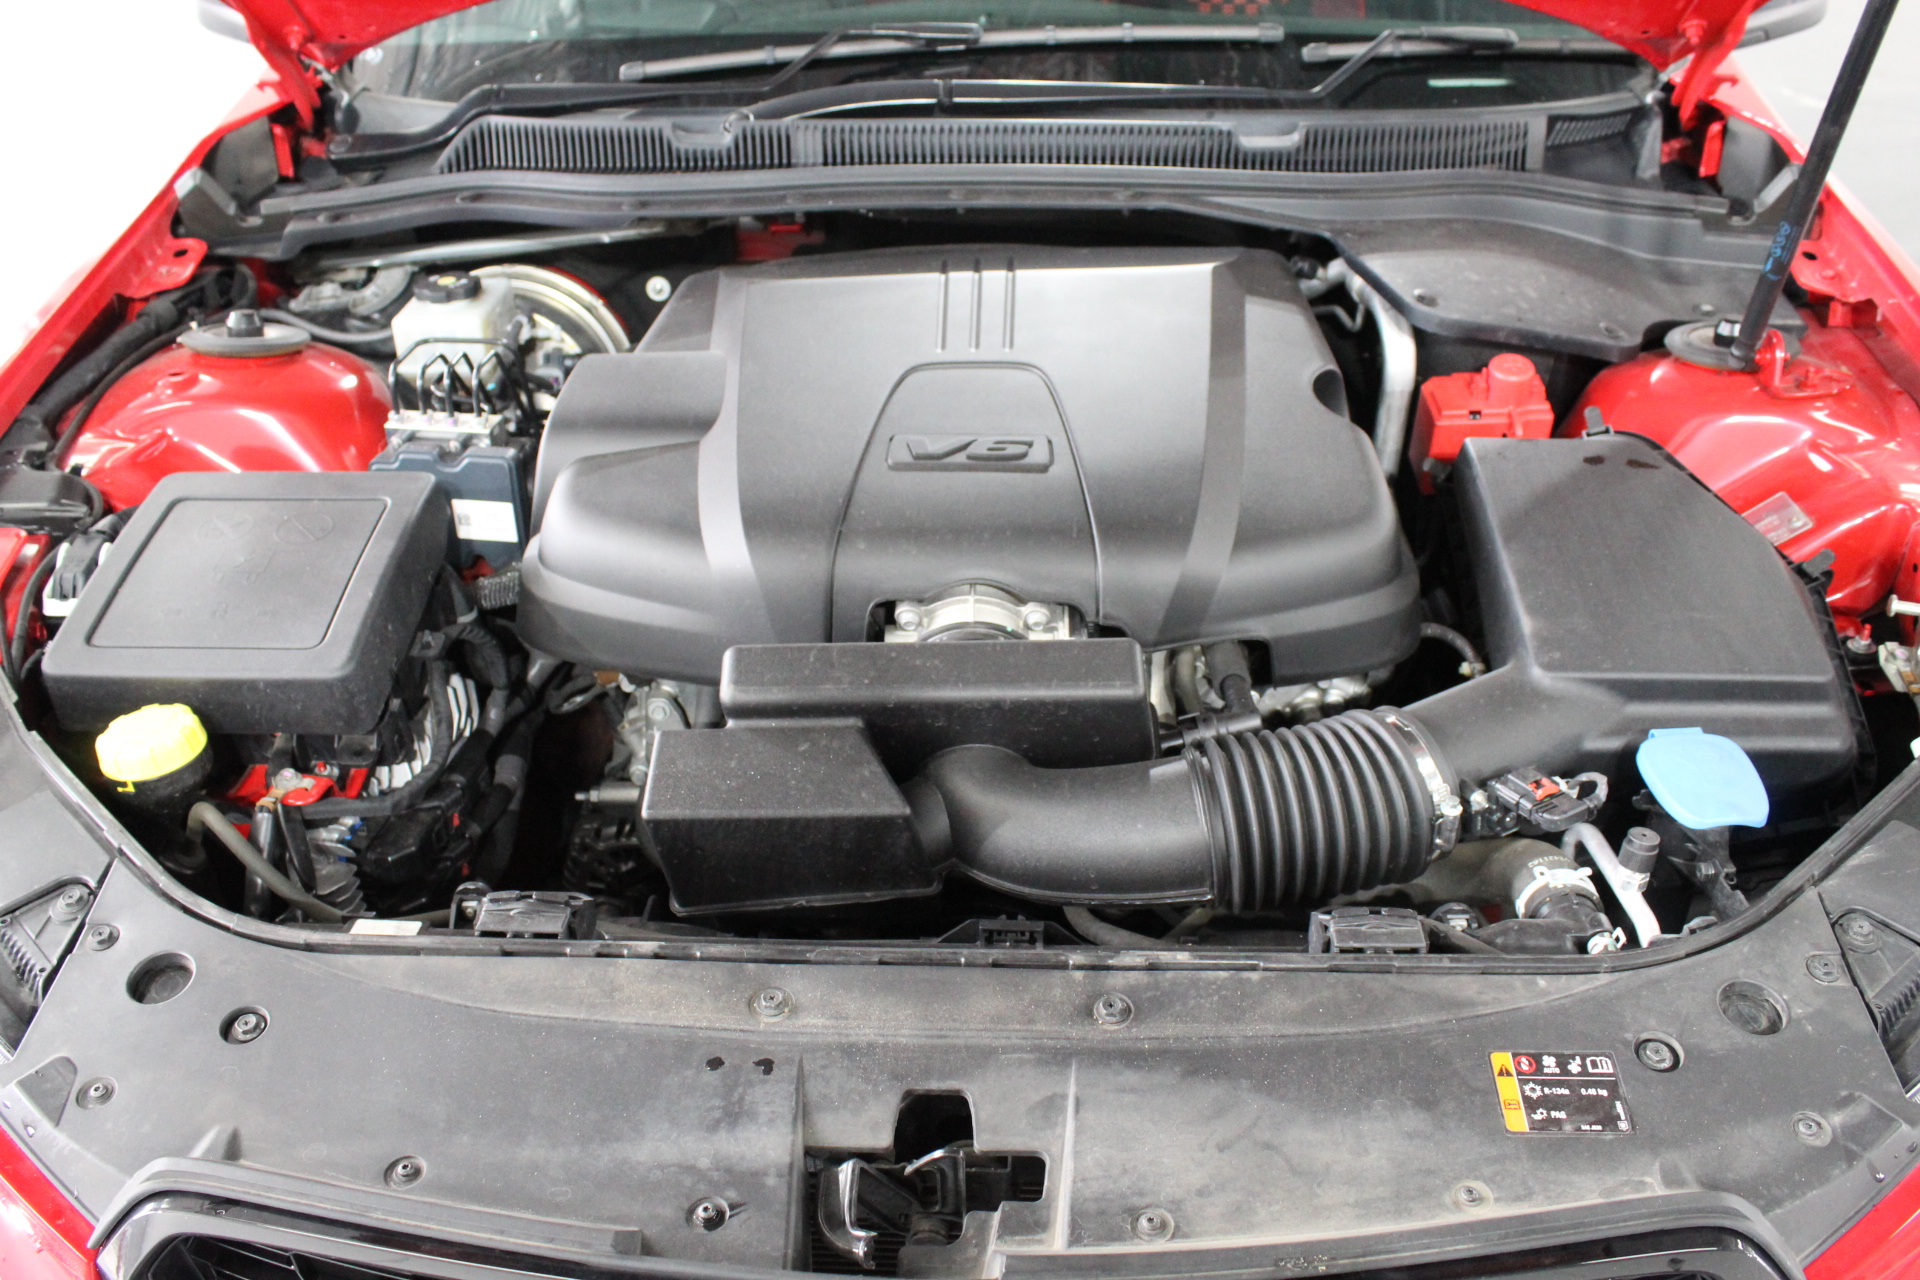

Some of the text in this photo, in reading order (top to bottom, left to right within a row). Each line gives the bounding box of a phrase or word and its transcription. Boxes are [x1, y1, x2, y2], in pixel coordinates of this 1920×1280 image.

[906, 436, 1035, 462] V6
[1543, 1087, 1570, 1095] R-134a
[1598, 1087, 1609, 1097] kg
[1550, 1110, 1567, 1119] PAG
